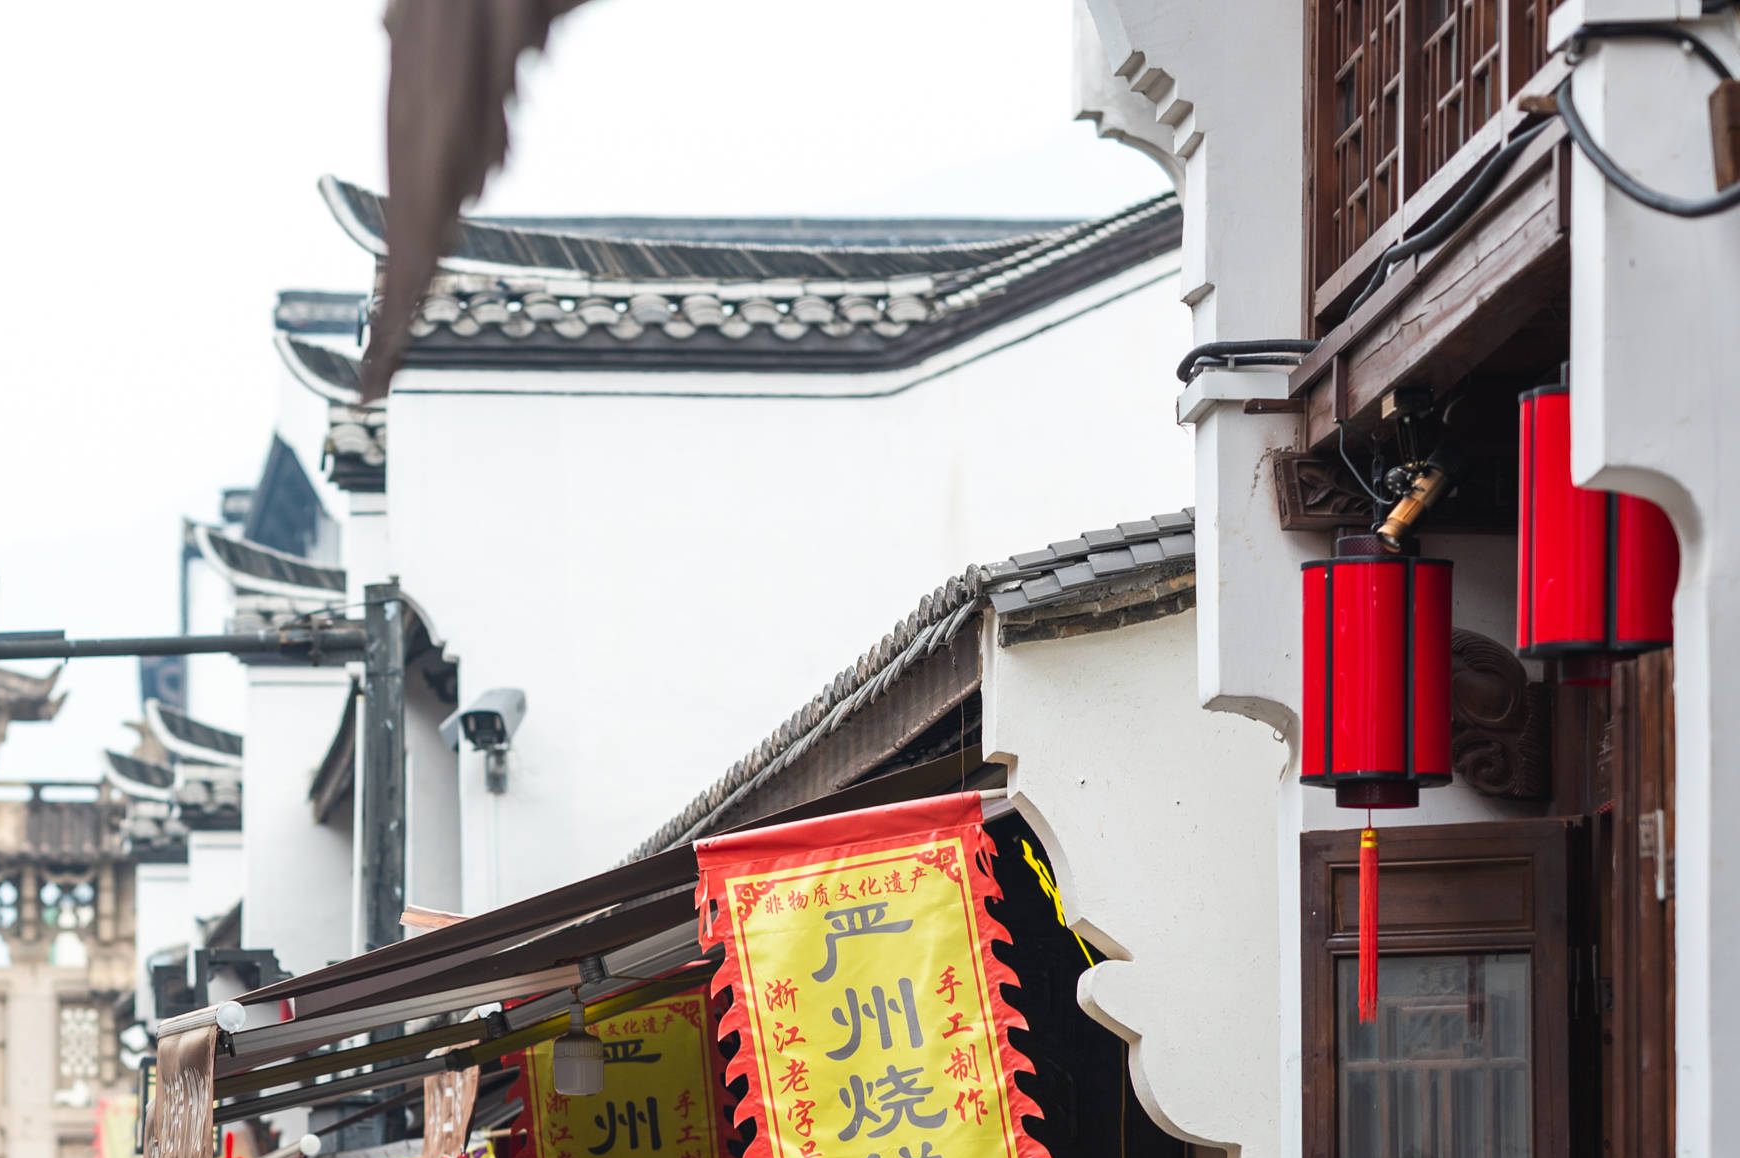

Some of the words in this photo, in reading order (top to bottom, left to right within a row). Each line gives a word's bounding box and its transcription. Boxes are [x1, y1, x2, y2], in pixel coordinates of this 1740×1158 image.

[764, 866, 930, 914] 非物质文化遗产
[589, 1012, 677, 1038] 质文化遗产
[935, 964, 989, 1126] 手工制作
